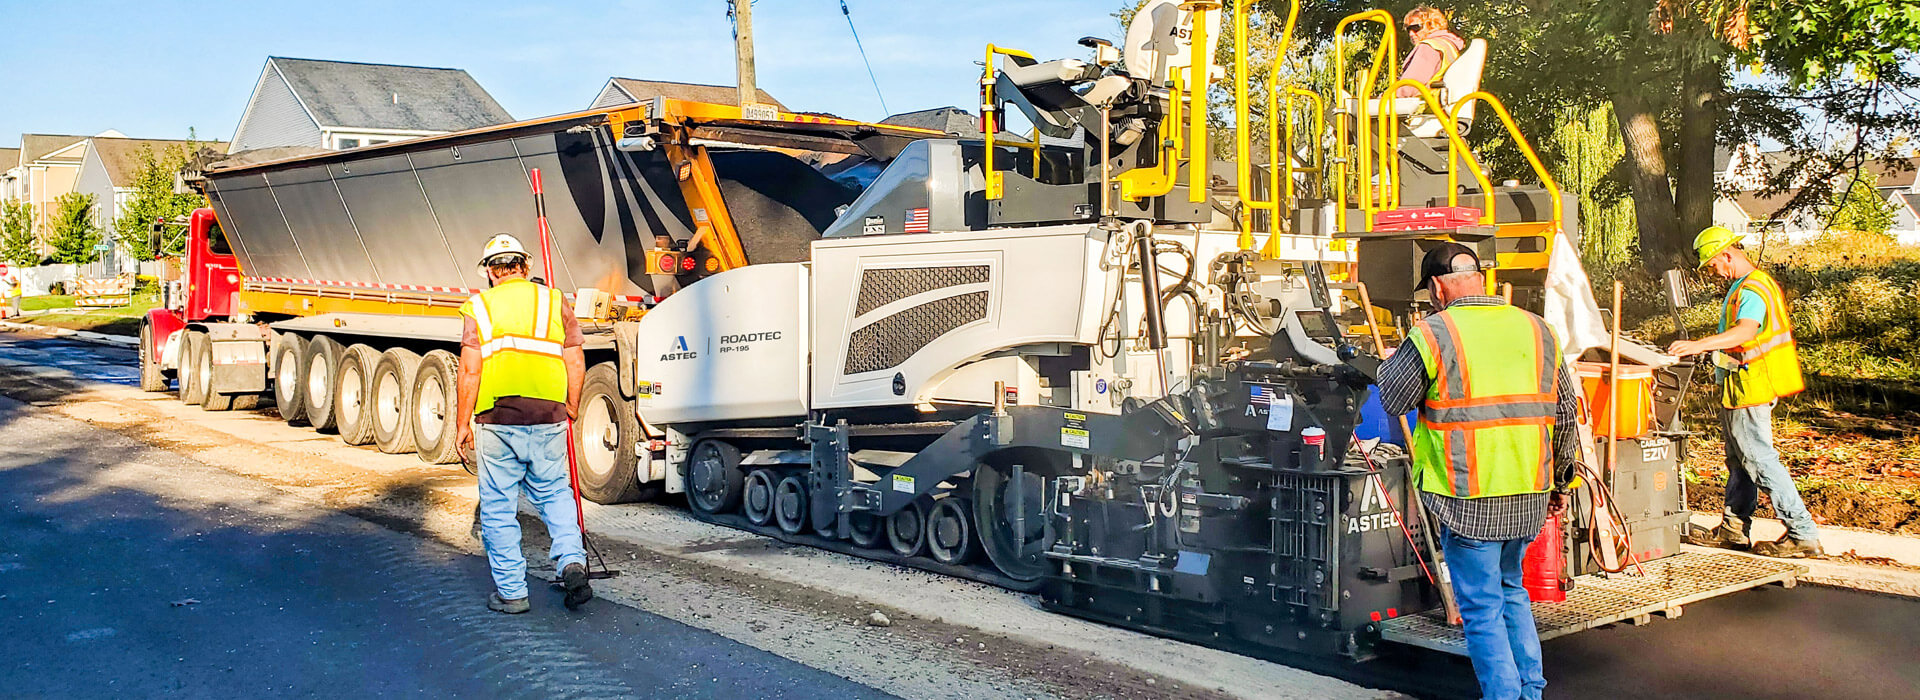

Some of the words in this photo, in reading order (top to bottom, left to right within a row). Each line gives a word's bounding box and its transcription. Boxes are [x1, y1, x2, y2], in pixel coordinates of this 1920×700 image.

[720, 331, 781, 344] ROADTEC
[719, 345, 750, 353] RP-195
[660, 351, 697, 361] ASTEC
[1640, 438, 1671, 448] CARLSON
[1642, 446, 1669, 462] EZIV
[1347, 511, 1401, 534] ASTEC
